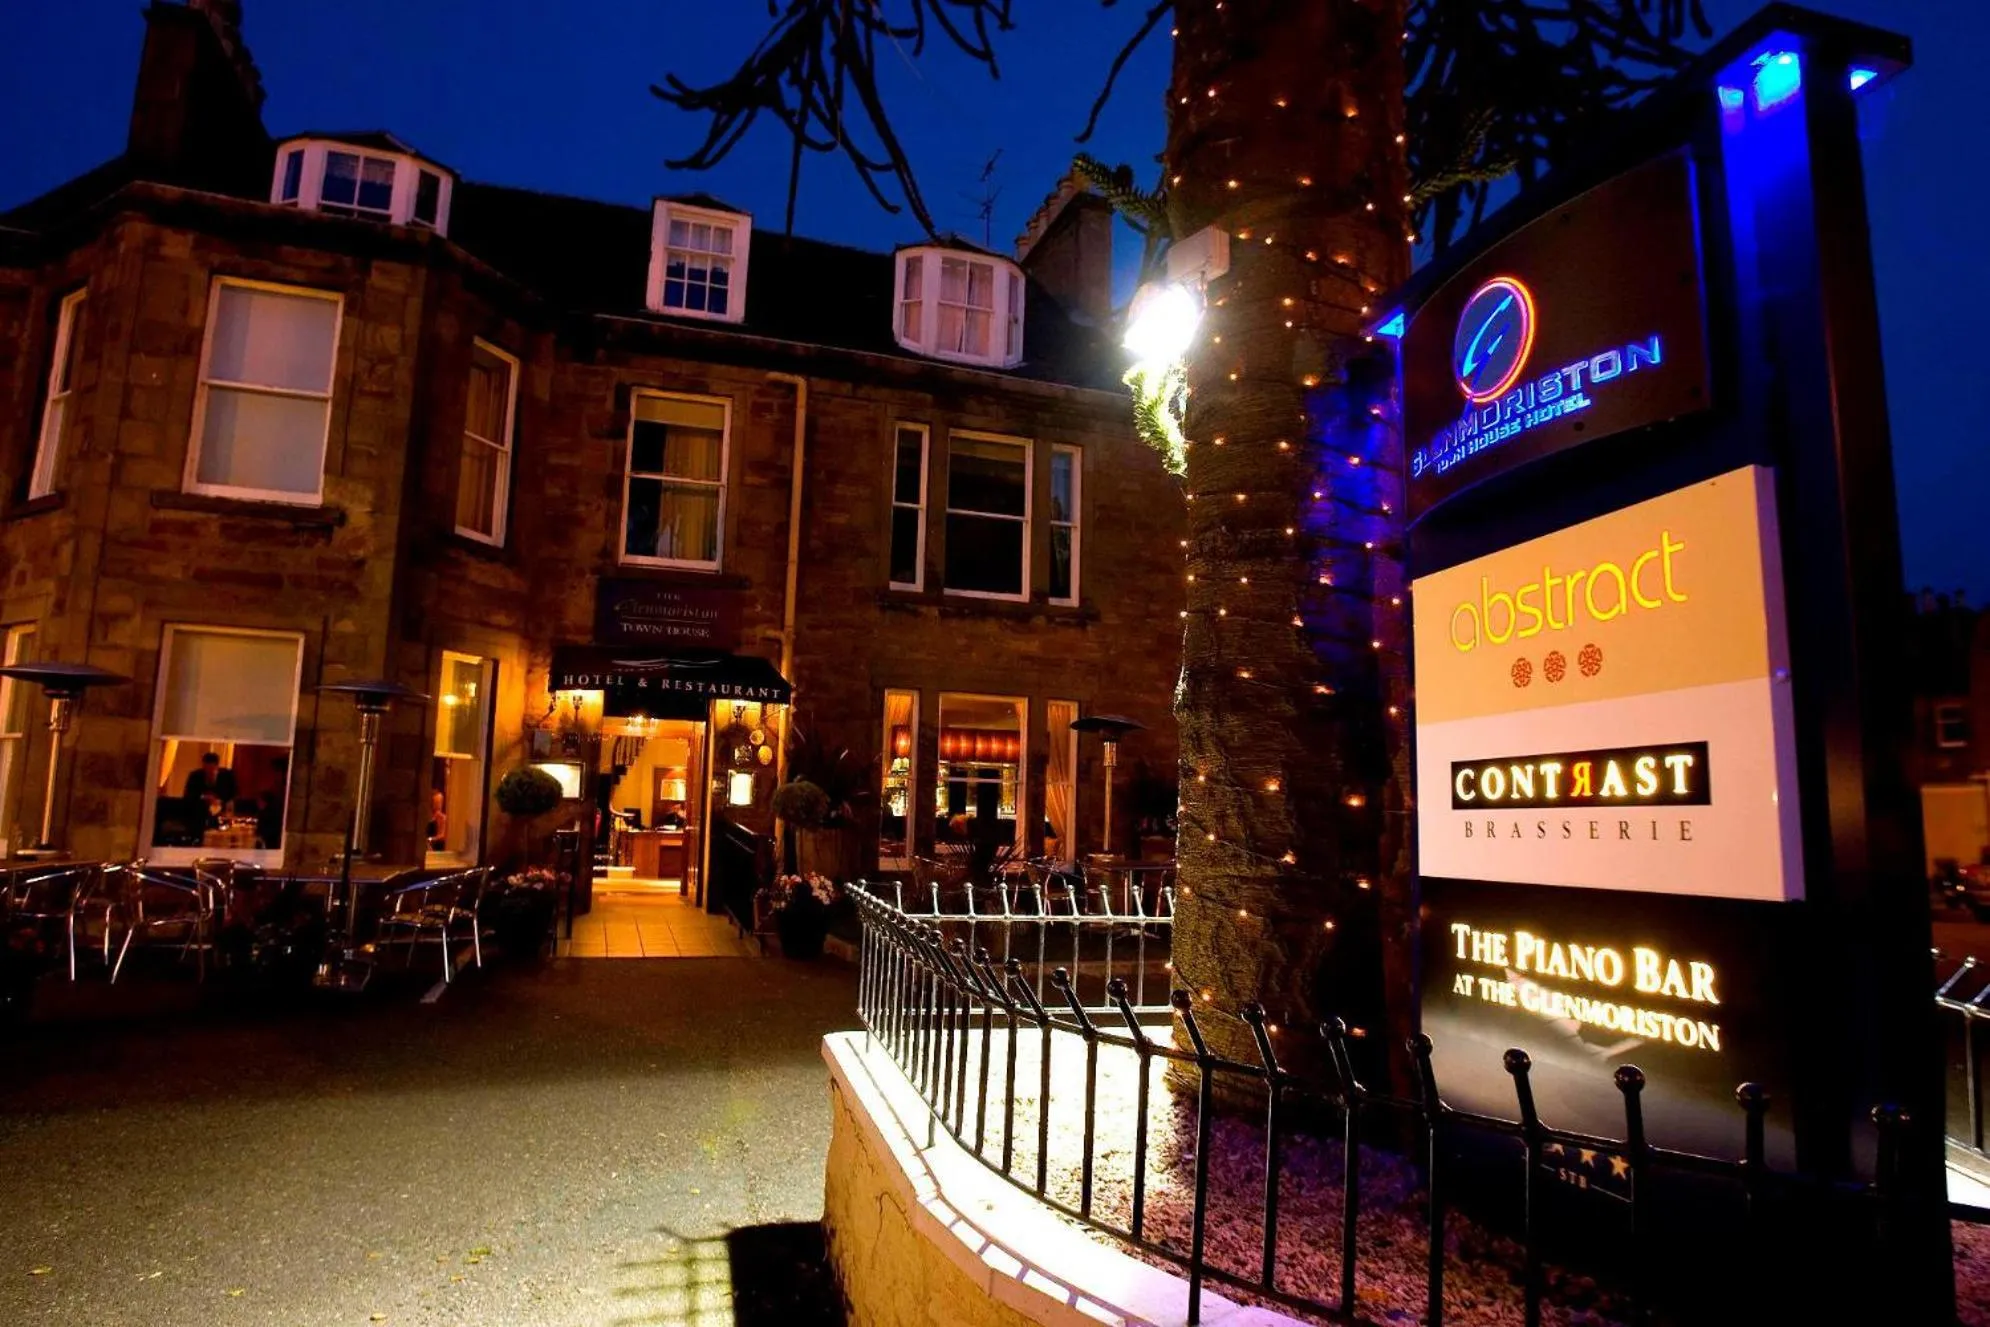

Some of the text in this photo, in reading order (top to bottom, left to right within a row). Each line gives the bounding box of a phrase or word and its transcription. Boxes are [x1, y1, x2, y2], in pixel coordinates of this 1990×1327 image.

[1437, 393, 1591, 474] TOWN HOUSE HOTEL
[1451, 530, 1688, 652] abstract
[564, 674, 781, 699] HOTEL & RESTAURANT
[1464, 819, 1694, 842] BRASSERIE
[1451, 922, 1721, 1006] THE PIANO BAR
[1452, 973, 1721, 1052] AT THE GLENMORISTON
[1558, 1167, 1589, 1190] STB
